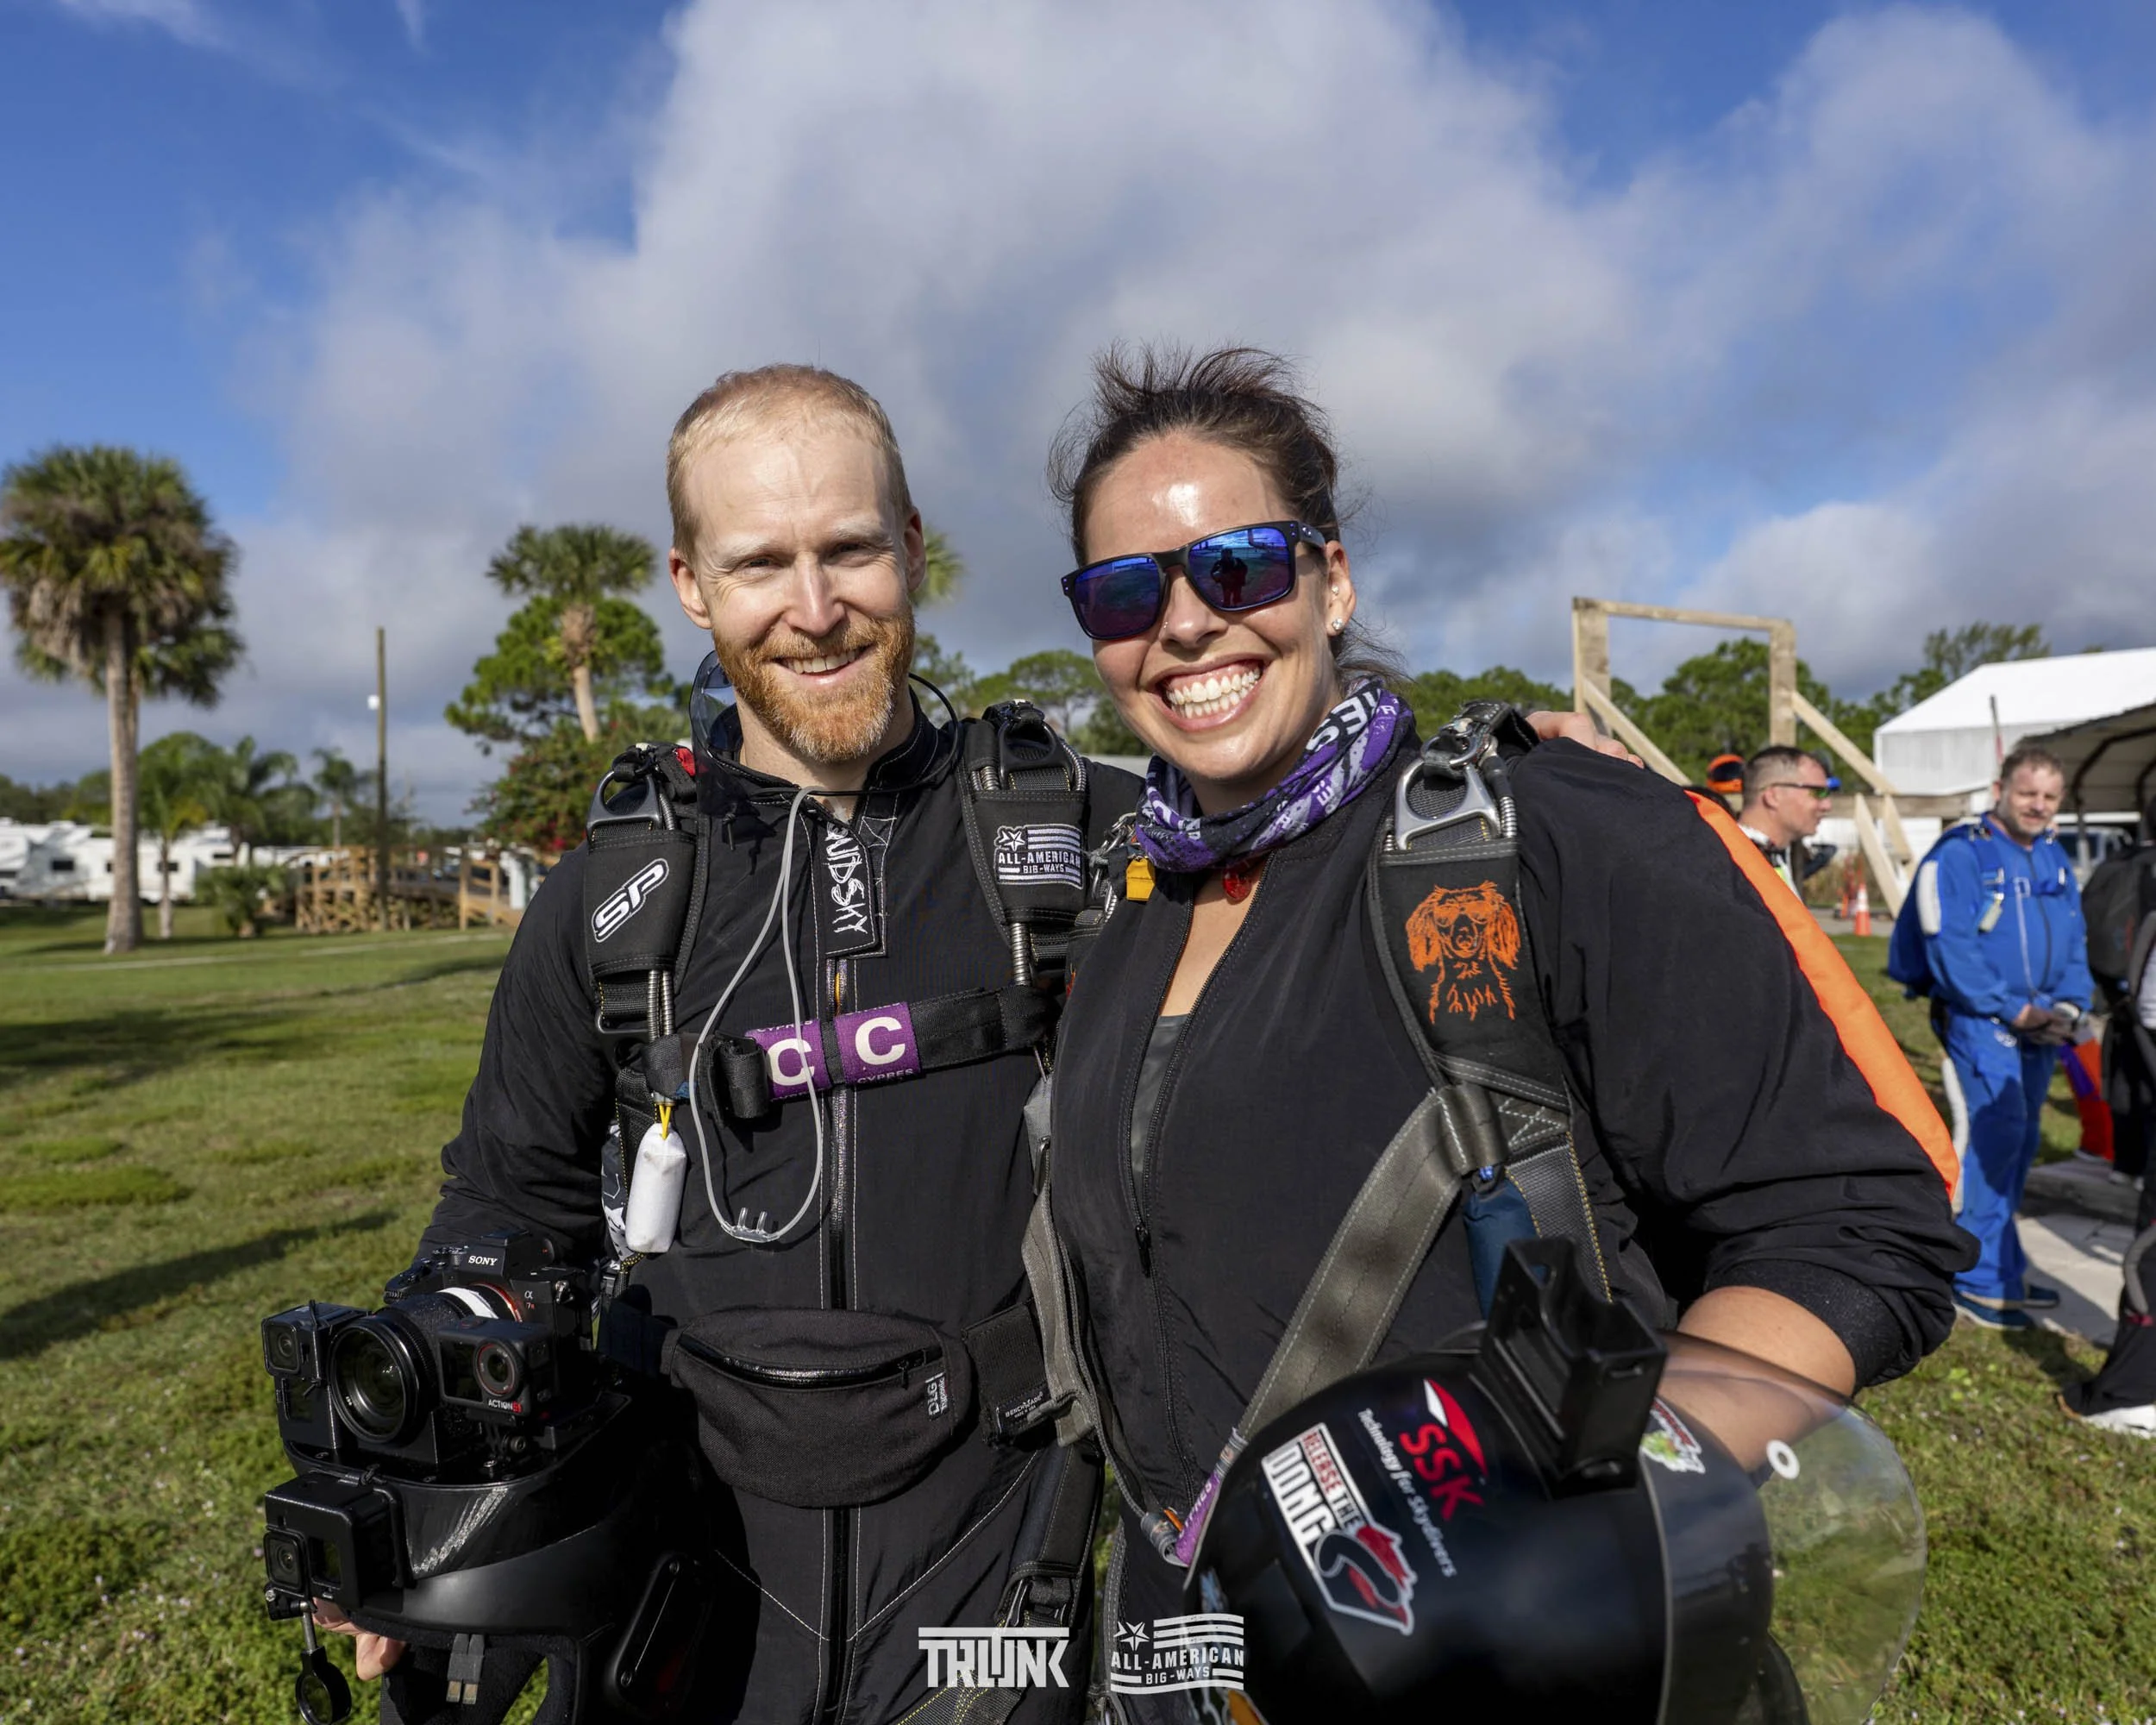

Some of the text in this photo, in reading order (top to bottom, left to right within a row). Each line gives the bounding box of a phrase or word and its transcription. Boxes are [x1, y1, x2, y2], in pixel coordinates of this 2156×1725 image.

[998, 850, 1081, 869] ALL-AMERICAN
[1023, 863, 1065, 874] BIG-WAYS
[593, 862, 666, 938] SP
[767, 1038, 816, 1087] C
[854, 1016, 906, 1066] C
[856, 1068, 914, 1085] CYPRES
[468, 1255, 498, 1266] SONY
[927, 1382, 940, 1415] DLG
[1268, 1443, 1337, 1546] DONG
[1303, 1430, 1362, 1530] RELEASE THE
[1357, 1408, 1457, 1578] Technology for Skydivers
[1398, 1423, 1486, 1522] SSK
